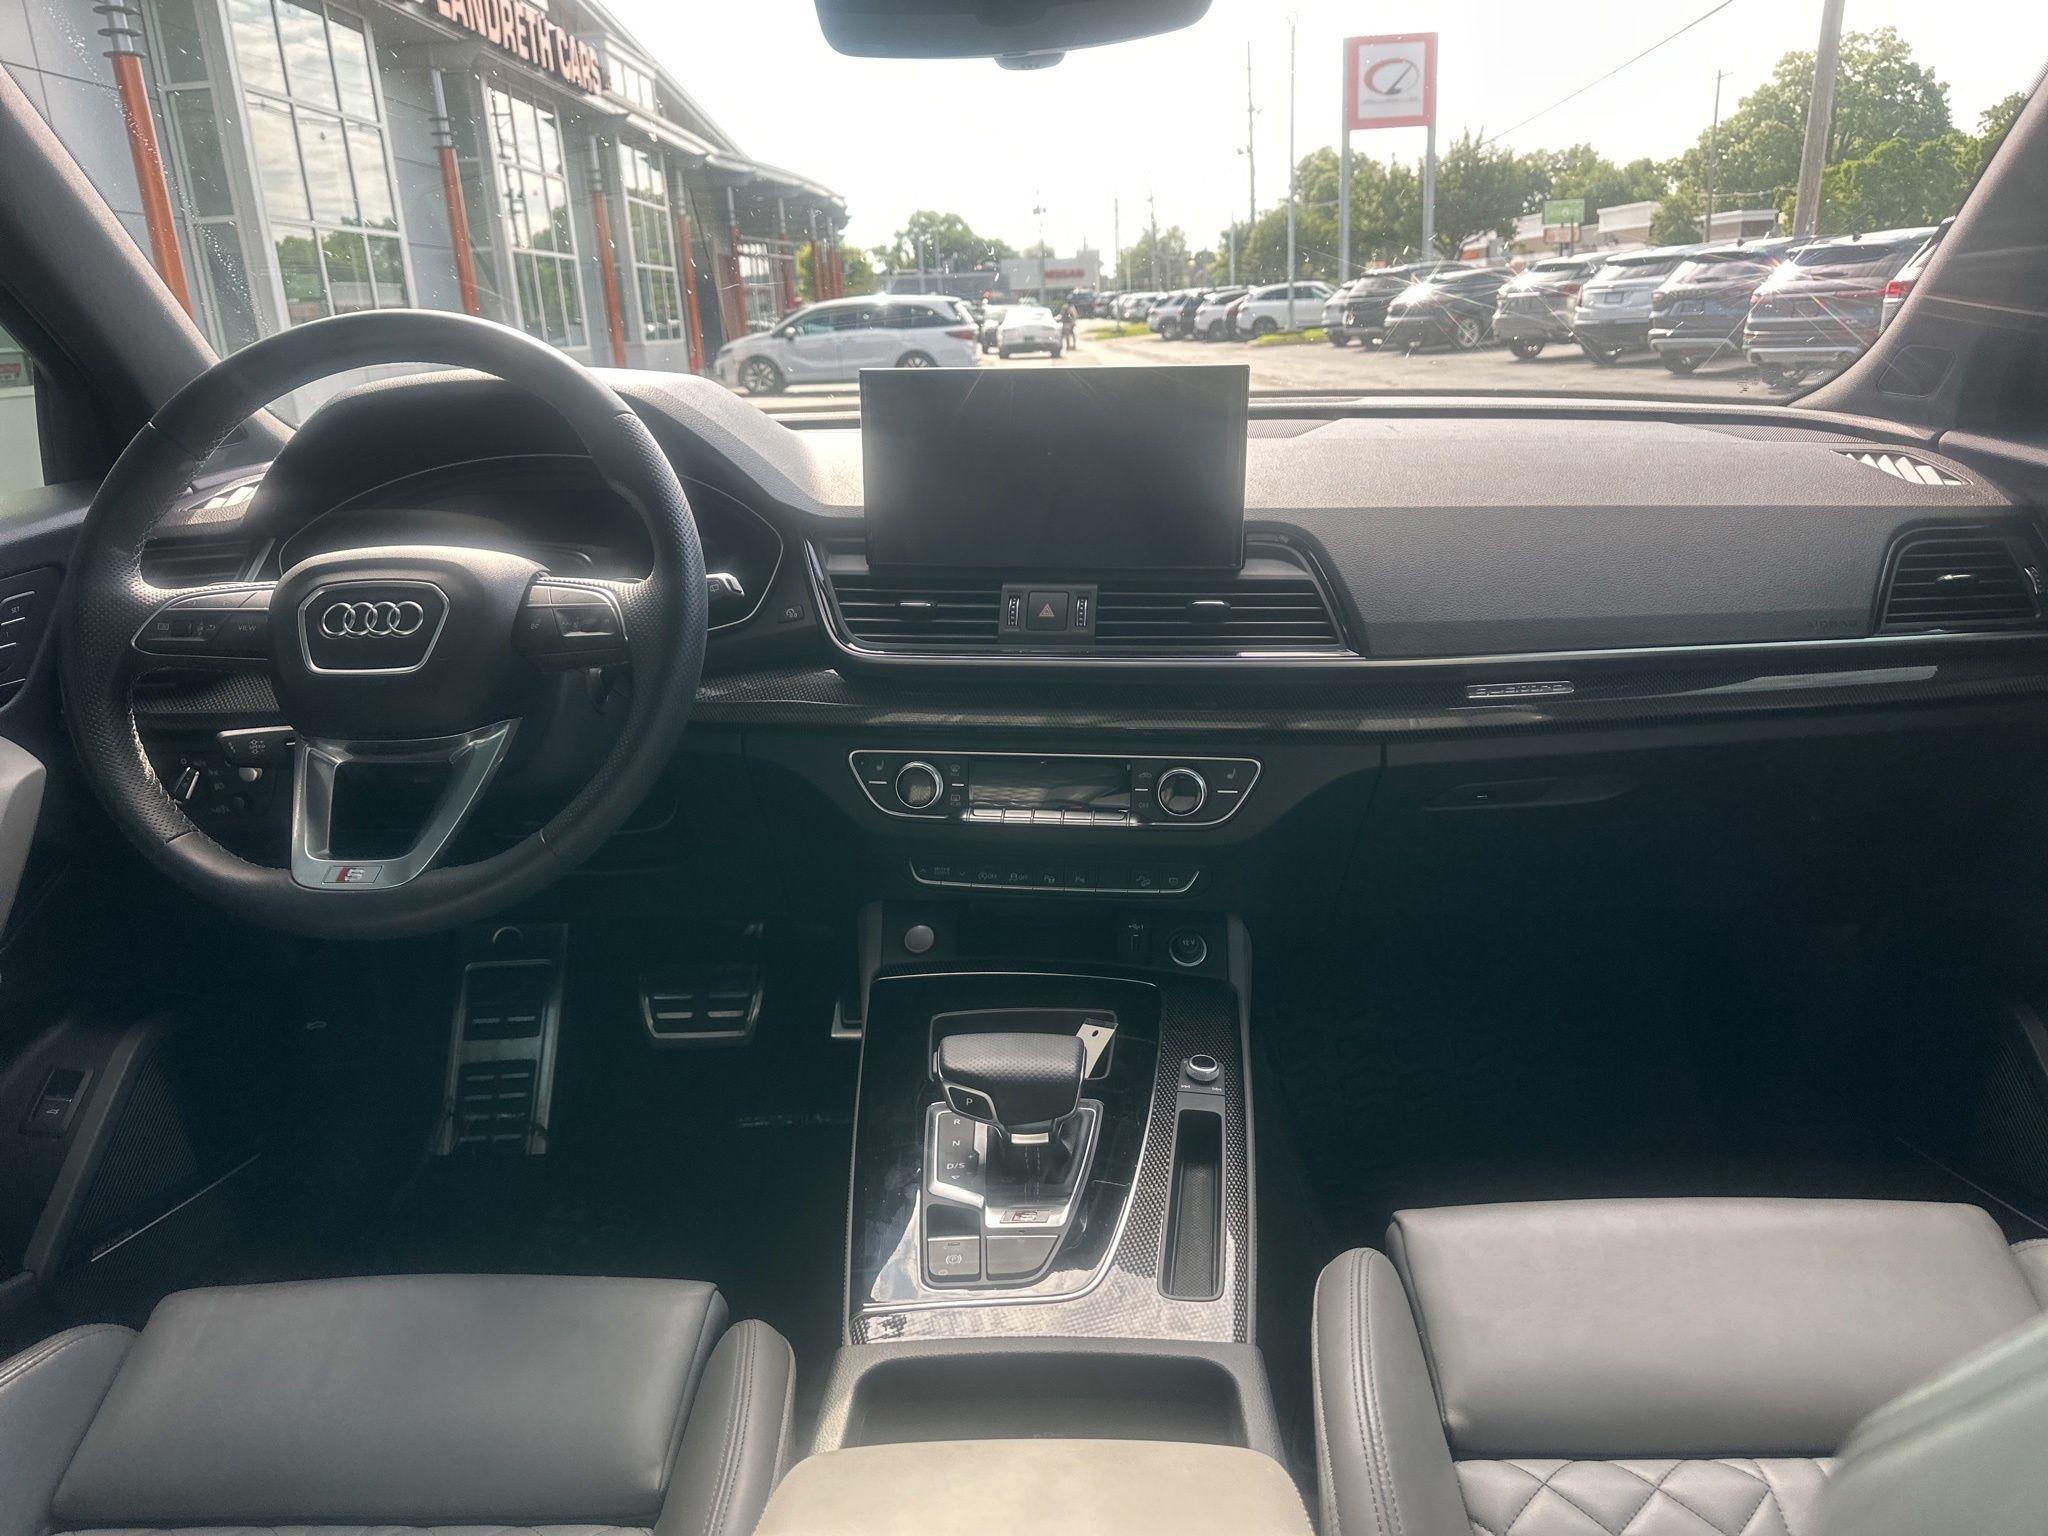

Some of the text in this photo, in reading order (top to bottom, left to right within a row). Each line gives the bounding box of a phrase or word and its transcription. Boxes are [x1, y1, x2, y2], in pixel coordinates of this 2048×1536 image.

[437, 0, 602, 95] NDRETH CARS
[966, 1098, 973, 1106] P
[946, 1162, 966, 1170] D/S
